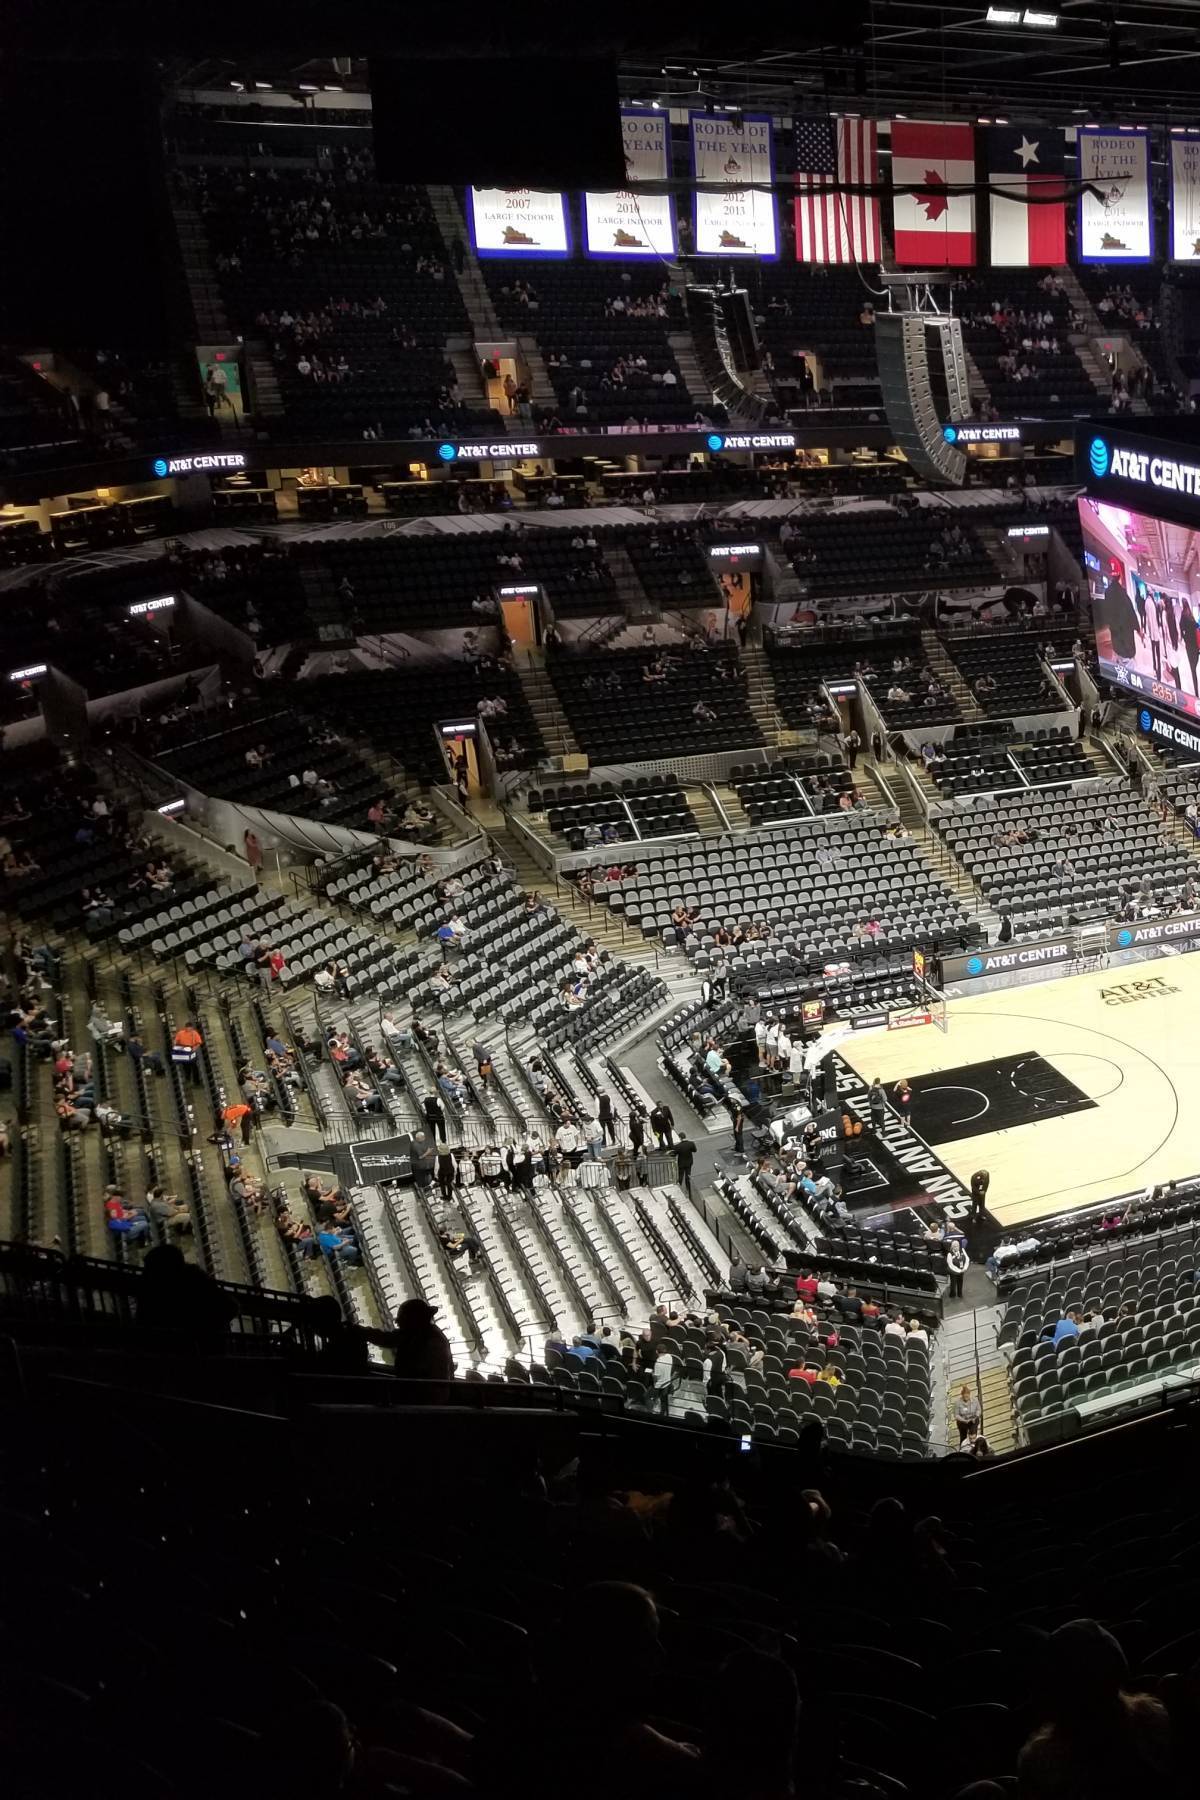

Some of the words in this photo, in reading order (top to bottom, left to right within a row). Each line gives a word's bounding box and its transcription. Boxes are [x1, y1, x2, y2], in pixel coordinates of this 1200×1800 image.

[644, 122, 663, 133] OF
[695, 124, 745, 135] RODEO
[750, 127, 767, 137] OF
[625, 139, 664, 151] YEAR
[698, 143, 727, 153] THE
[731, 144, 768, 154] YEAR
[1092, 140, 1135, 150] RODEO
[1092, 155, 1107, 164] OF
[1111, 155, 1137, 165] THE
[1183, 162, 1199, 171] OF
[506, 199, 530, 209] 2007
[485, 212, 513, 221] LARGE
[723, 206, 745, 216] 2013
[958, 428, 981, 440] AT&T
[982, 428, 1020, 439] CENTER
[724, 436, 752, 448] AT&T
[752, 435, 795, 447] CENTER
[457, 446, 488, 457] AT&T
[489, 444, 538, 456] CENTER
[169, 458, 192, 472] AT&T
[193, 454, 245, 468] CENTER
[1110, 448, 1150, 482] AT&T
[1130, 674, 1143, 689] SA
[1152, 682, 1178, 704] 23:51
[1152, 718, 1174, 740] AT&T
[1134, 927, 1164, 942] AT&T
[986, 953, 1018, 970] AT&T
[1018, 944, 1068, 963] CENTER
[1097, 976, 1167, 999] AT&T
[1105, 986, 1182, 1006] CENTER
[918, 1173, 973, 1218] SAN
